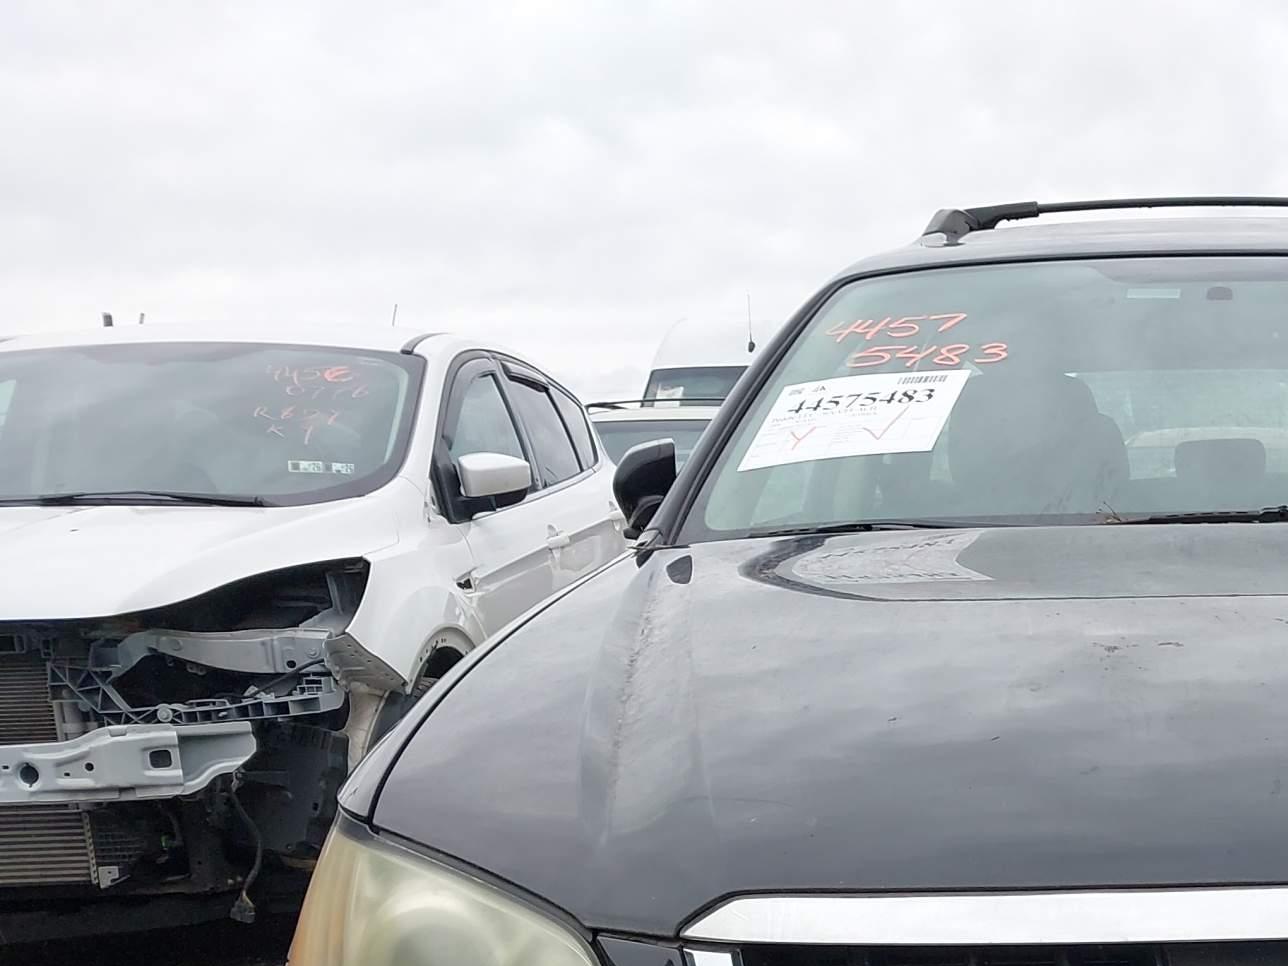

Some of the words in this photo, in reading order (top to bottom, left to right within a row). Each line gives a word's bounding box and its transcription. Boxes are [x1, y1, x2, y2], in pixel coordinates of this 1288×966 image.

[826, 313, 968, 343] 4457
[846, 343, 1009, 368] 5483
[787, 388, 935, 413] 44575483
